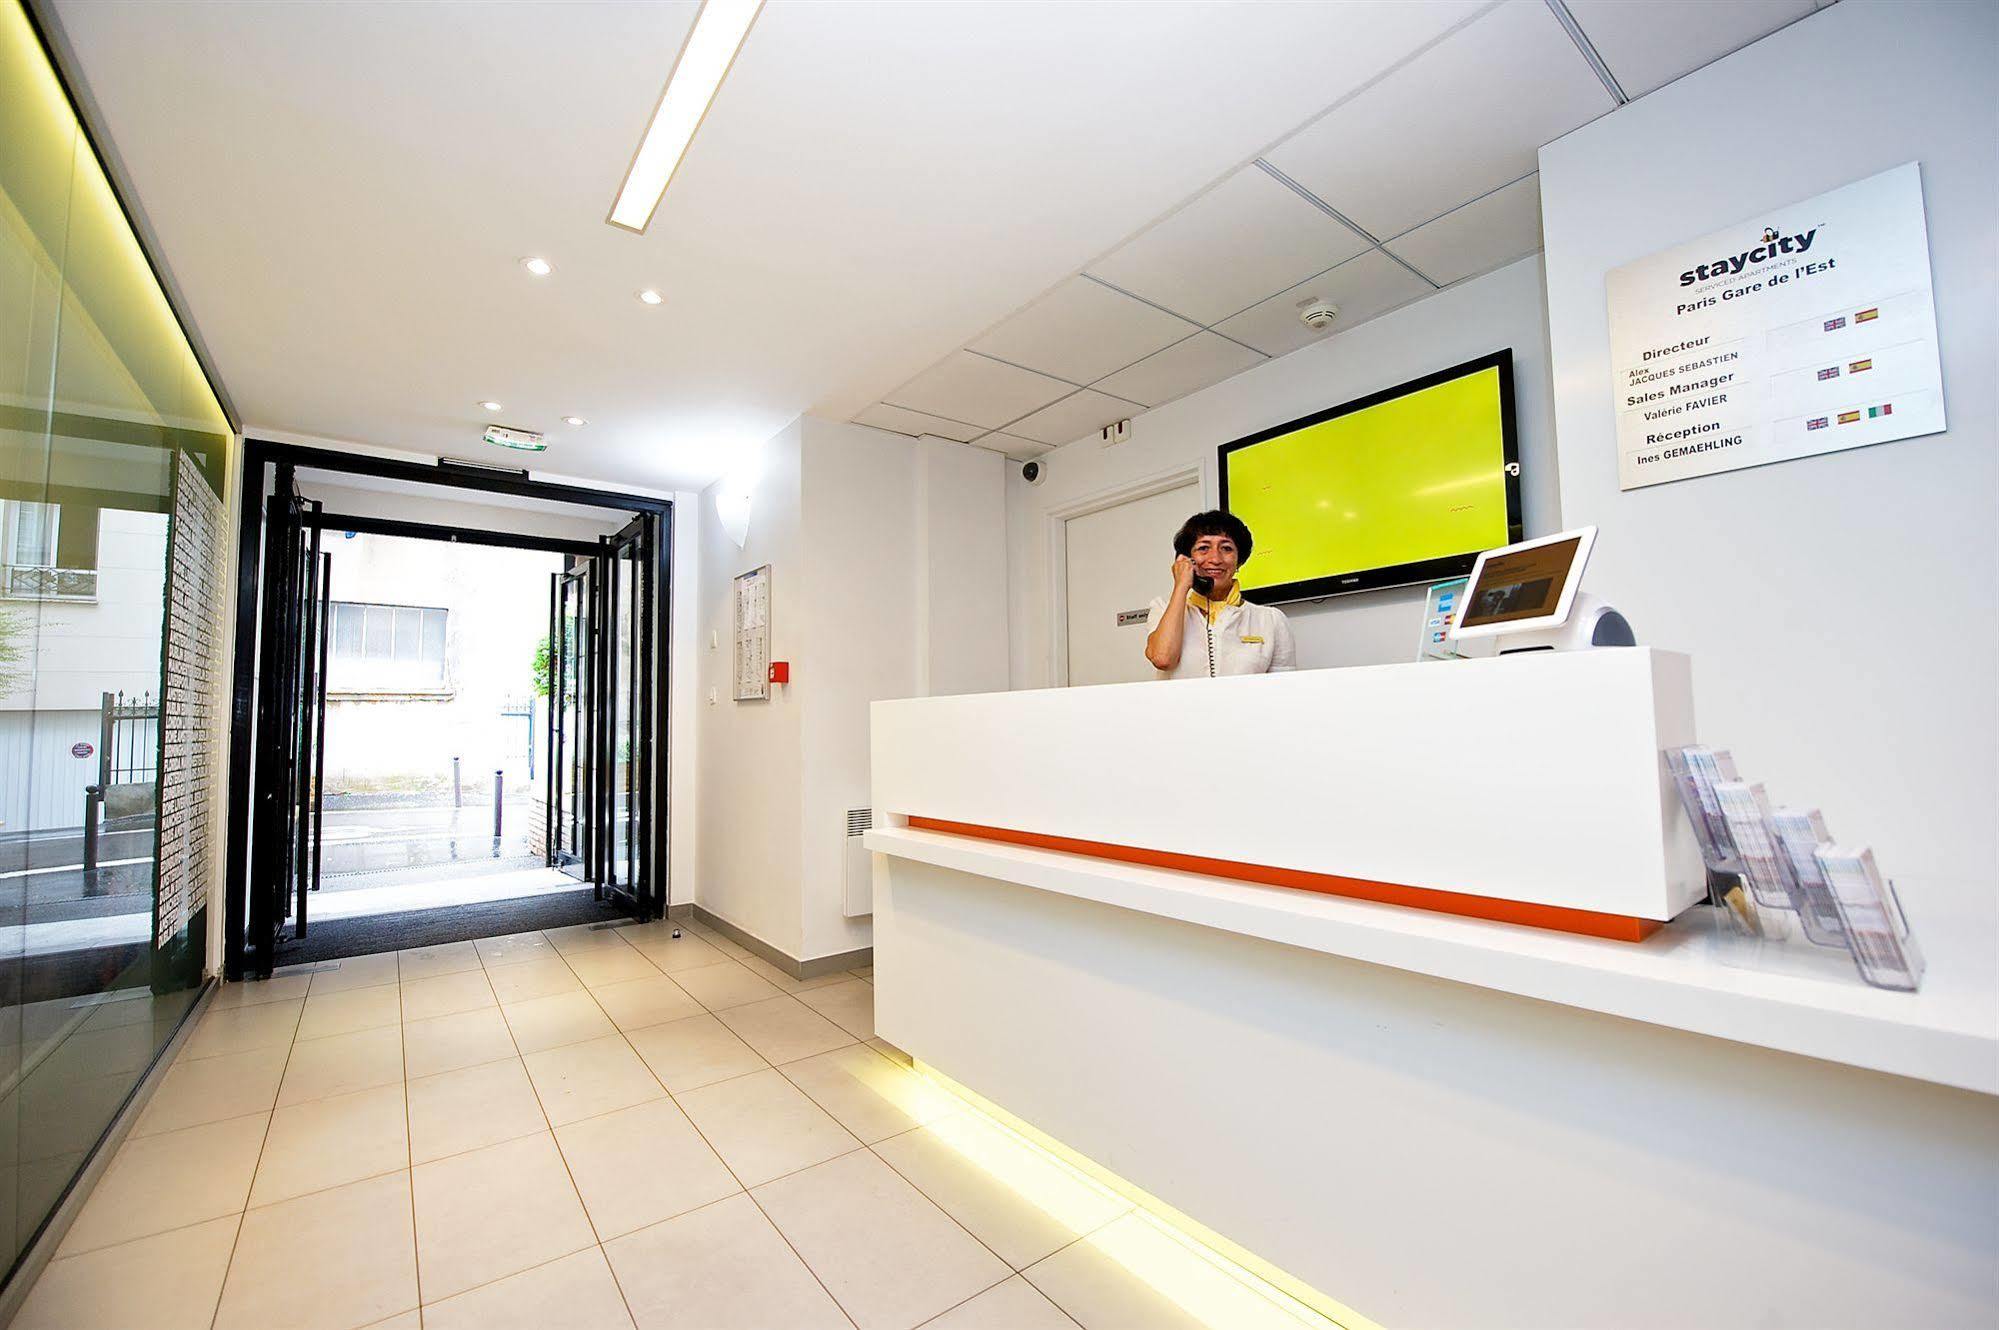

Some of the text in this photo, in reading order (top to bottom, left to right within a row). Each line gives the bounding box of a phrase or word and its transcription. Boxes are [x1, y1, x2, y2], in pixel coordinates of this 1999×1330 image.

[1680, 228, 1817, 287] staycity
[1676, 257, 1836, 316] Paris Gare de l'Est
[1643, 336, 1711, 361] Directeur
[1628, 368, 1649, 378] Alex
[1629, 352, 1738, 386] JACQUES SEBASTIEN
[1627, 373, 1734, 406] Sales Manager
[1643, 394, 1727, 421] Valérie FAVIER
[1646, 422, 1720, 444] Réception
[1636, 435, 1742, 465] Ines GEMAEHLING
